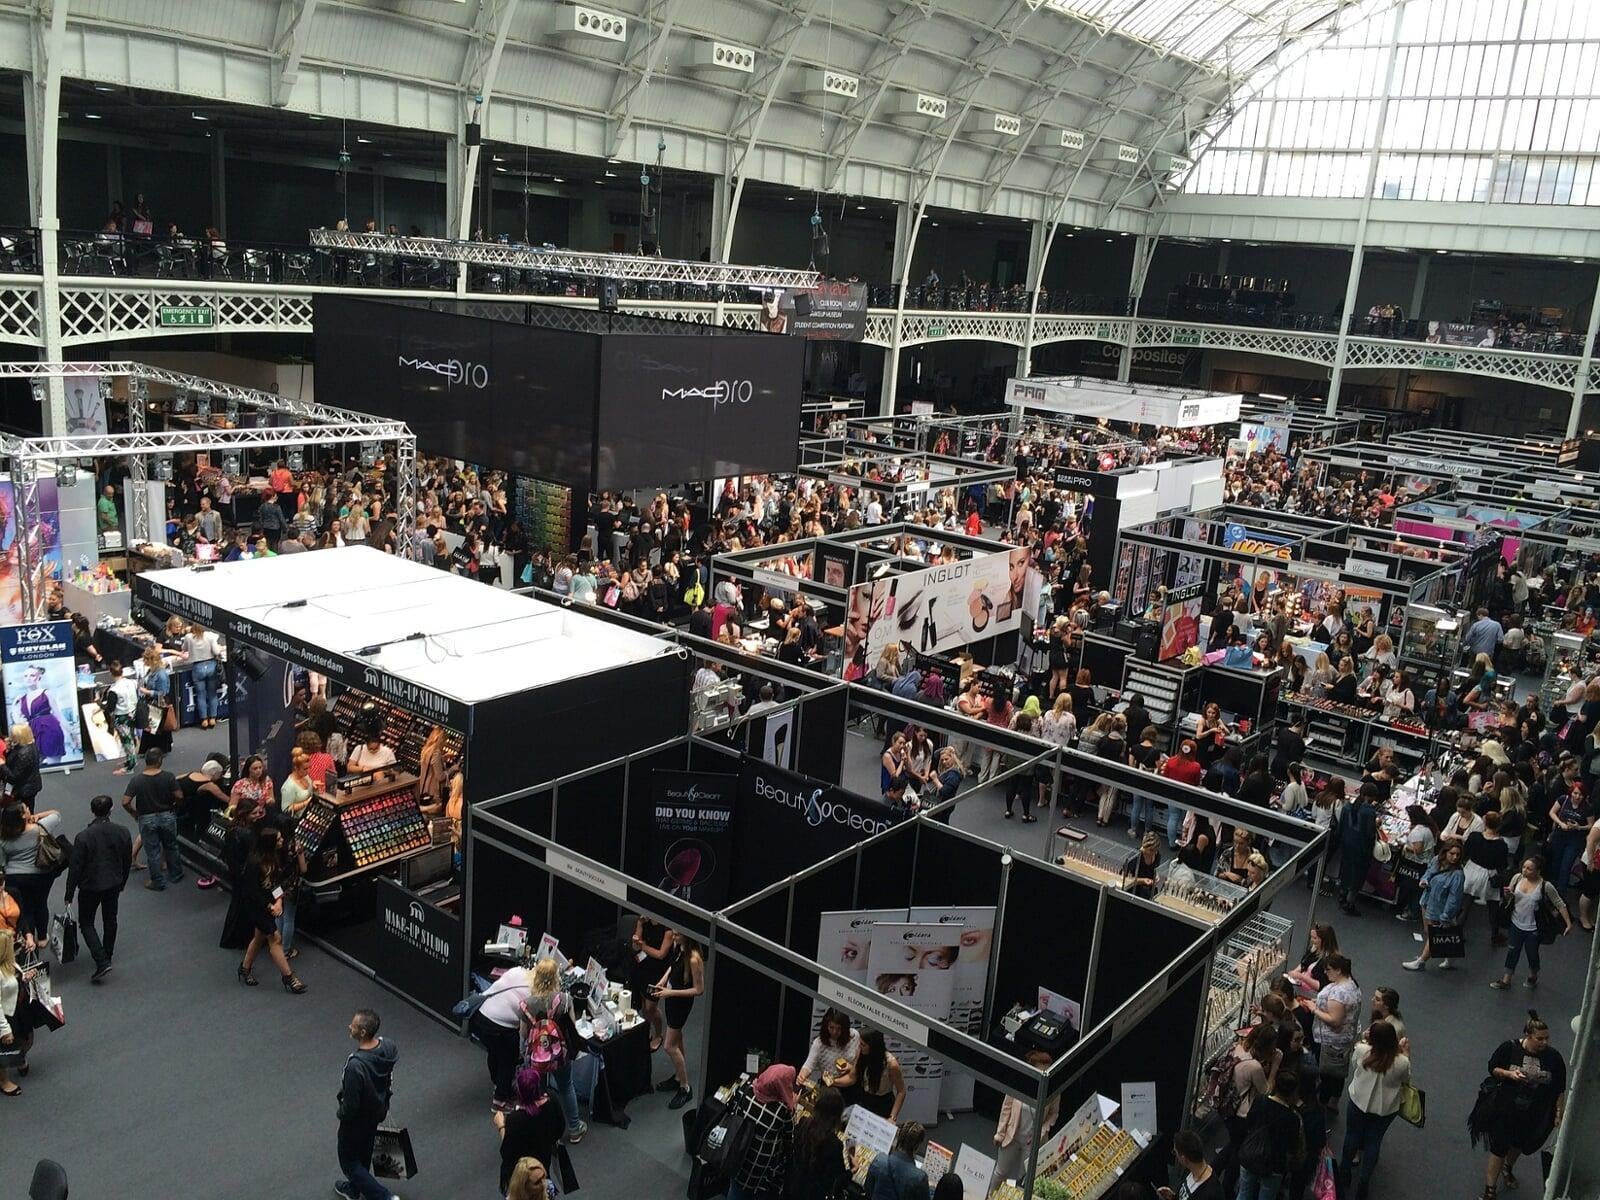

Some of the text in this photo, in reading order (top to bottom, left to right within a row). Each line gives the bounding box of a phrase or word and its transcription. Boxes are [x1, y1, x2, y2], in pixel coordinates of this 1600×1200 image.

[1102, 344, 1187, 365] Coposites
[1073, 476, 1092, 487] PRO
[923, 563, 972, 587] INGLOT
[1171, 584, 1201, 601] INGLOT
[15, 624, 56, 641] FOX
[237, 620, 252, 637] art
[257, 631, 289, 653] makeup
[300, 647, 344, 674] Amsterdam
[22, 652, 55, 660] LONDON
[381, 674, 418, 703] MAKE-UP
[419, 689, 449, 715] STUDIO
[655, 806, 731, 822] DID YOU KNOW
[1399, 867, 1420, 879] IMATS
[384, 907, 450, 958] MAKE-UP STUDIO
[1432, 935, 1461, 945] IMATS
[866, 1005, 881, 1017] FALSE
[881, 1011, 910, 1030] EYELASHES
